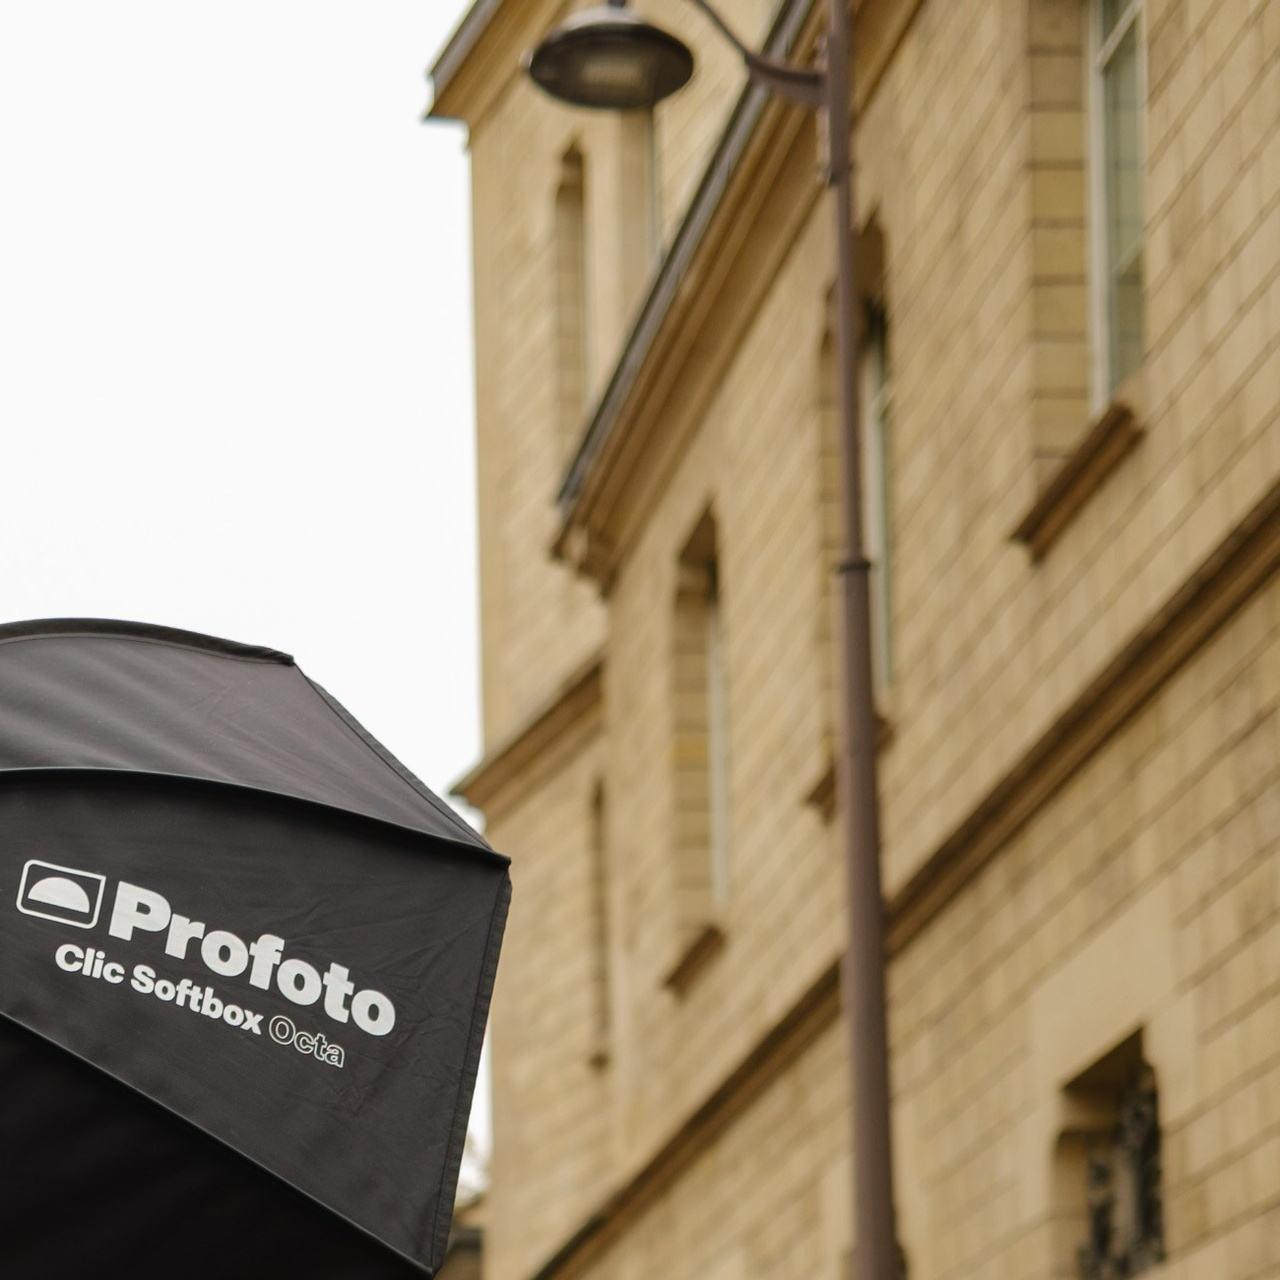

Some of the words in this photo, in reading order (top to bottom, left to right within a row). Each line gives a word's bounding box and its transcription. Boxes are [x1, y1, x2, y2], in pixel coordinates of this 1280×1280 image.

[55, 943, 125, 984] Clic
[130, 964, 263, 1036] Softbox
[268, 1014, 345, 1069] Octa
[108, 880, 396, 1037] Profoto
